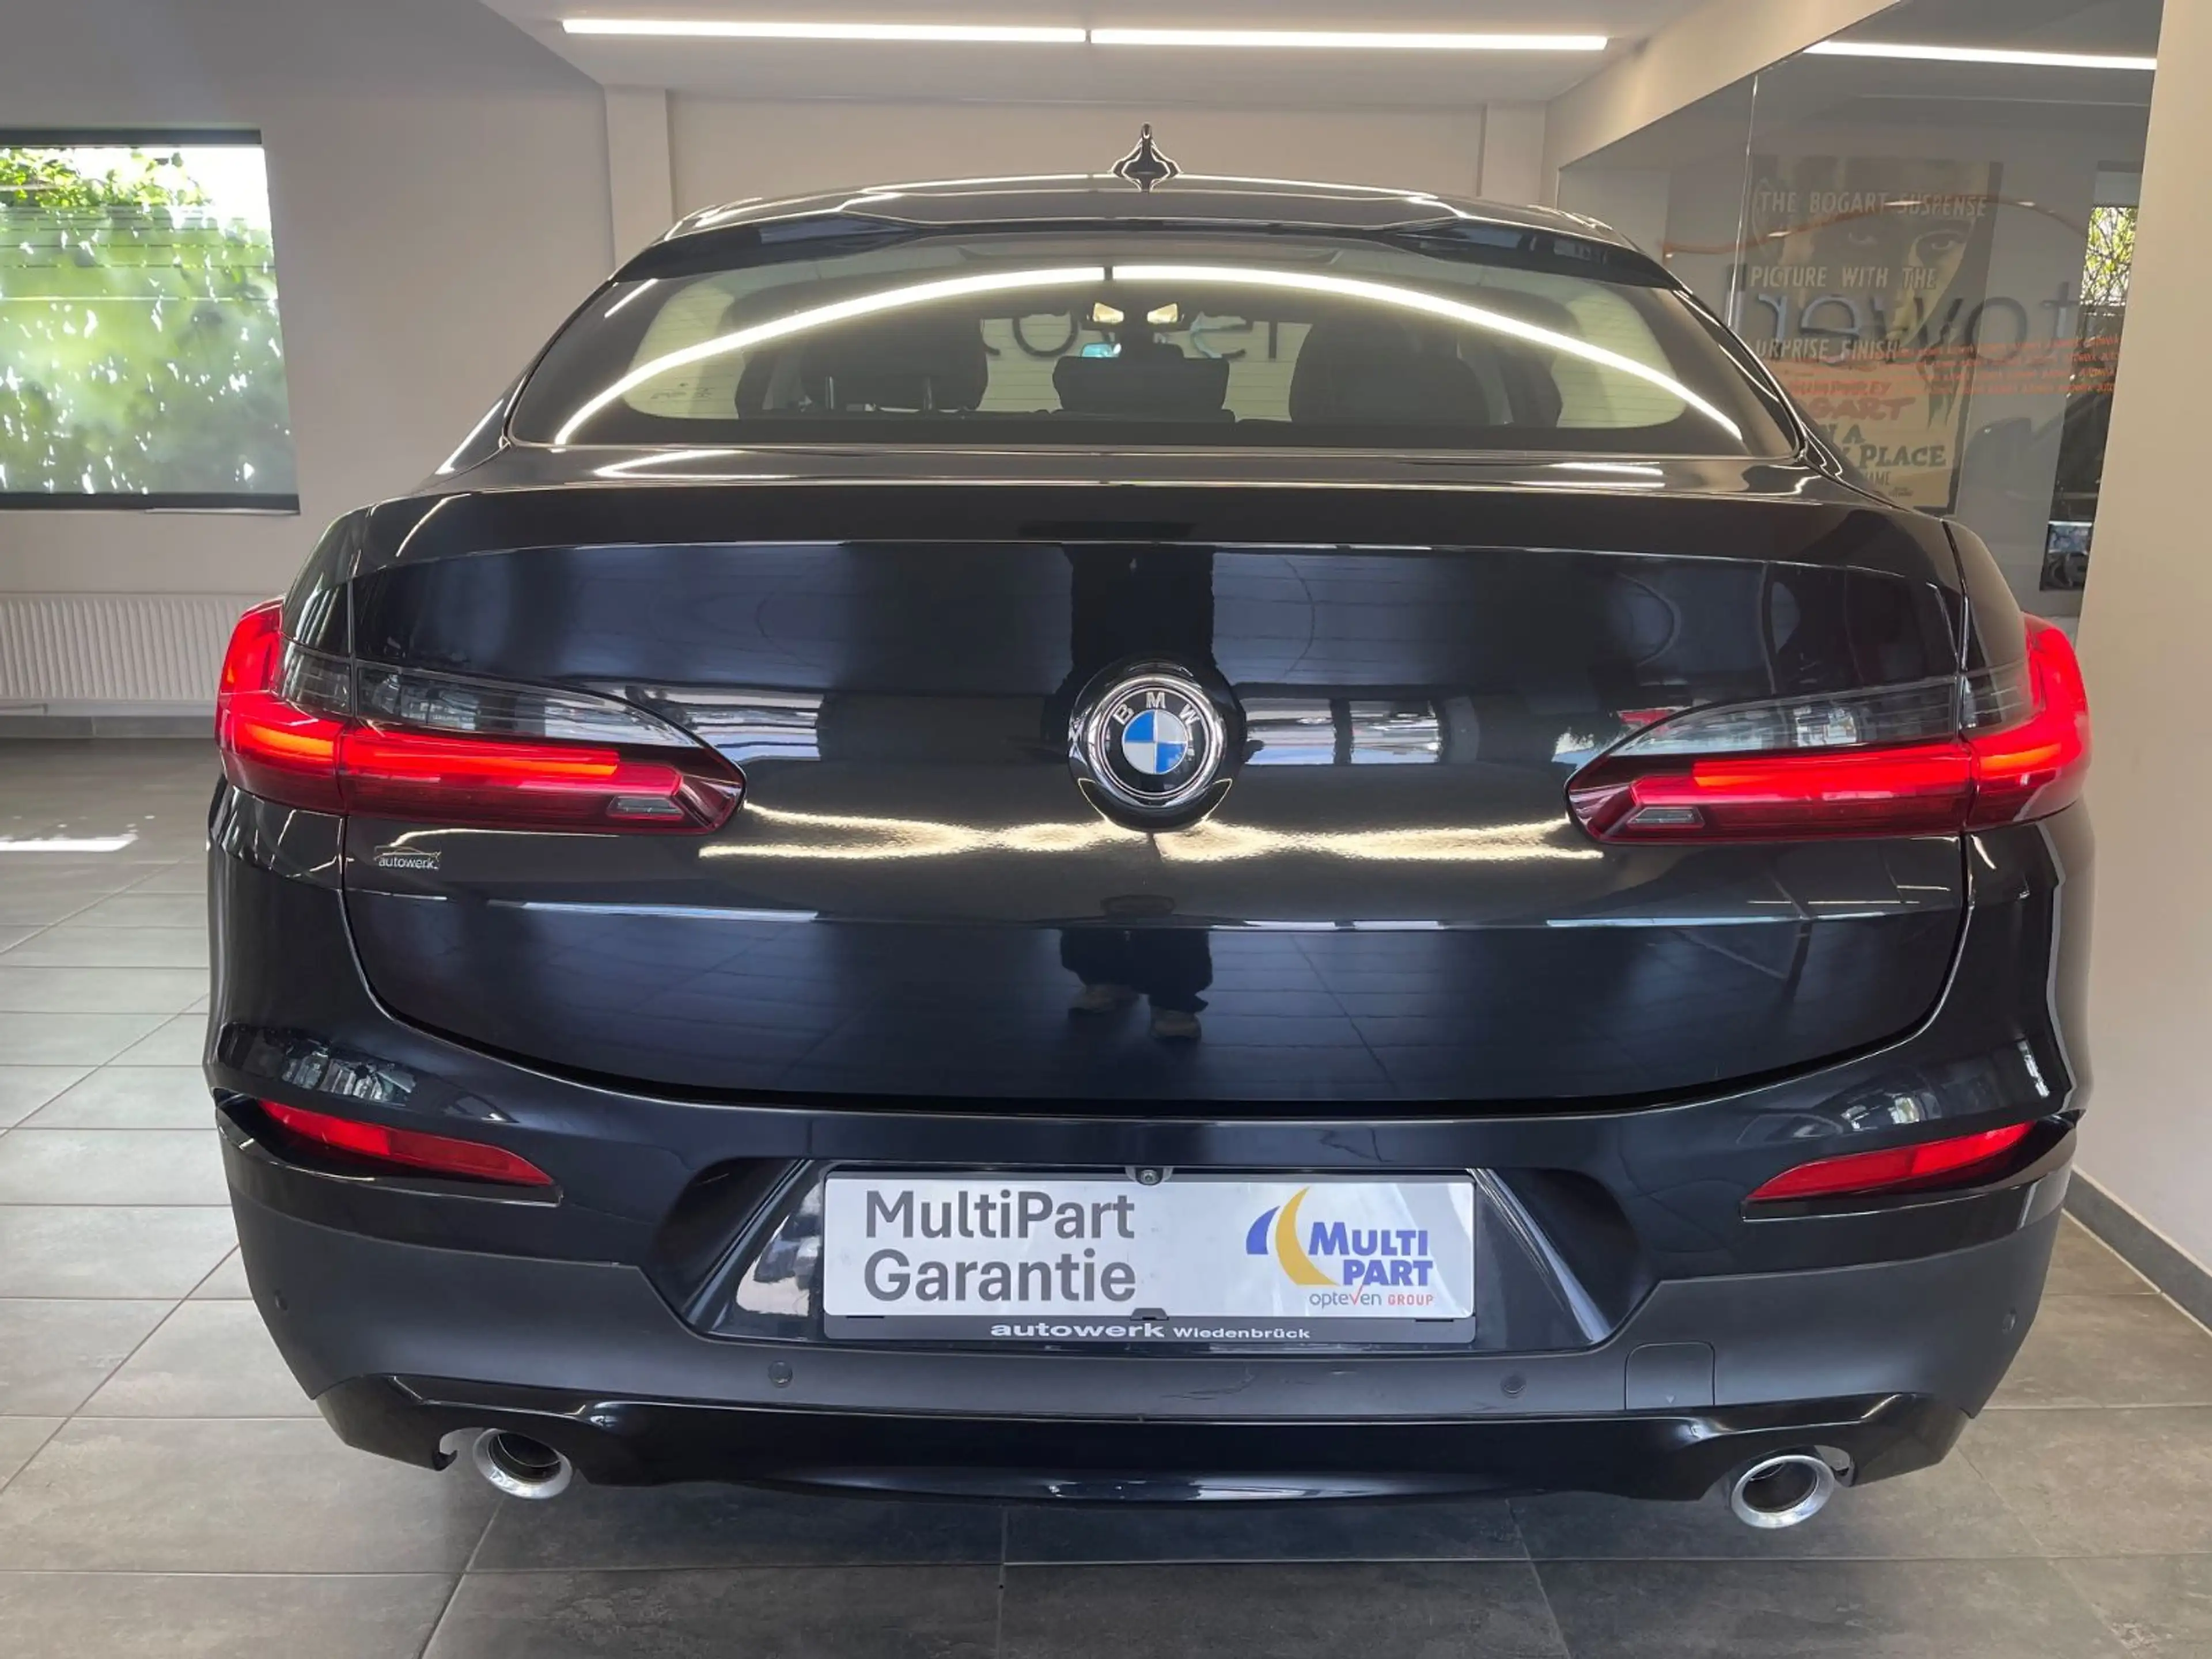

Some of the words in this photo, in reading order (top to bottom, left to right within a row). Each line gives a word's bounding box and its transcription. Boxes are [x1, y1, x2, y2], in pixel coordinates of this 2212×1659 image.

[1760, 191, 1797, 213] THE
[1809, 192, 1890, 215] BOGART
[1897, 194, 1987, 217] SUSPENSE
[1750, 266, 1827, 287] PICTURE
[1843, 267, 1889, 288] WITH
[1903, 267, 1937, 289] THE
[1751, 338, 1830, 360] URPRISE
[1859, 444, 1946, 469] PLACE
[1112, 691, 1200, 726] BMW
[866, 1189, 1135, 1238] MultiPart
[1308, 1221, 1428, 1256] MULTI
[865, 1248, 1136, 1302] Garantie
[1343, 1259, 1433, 1286] PART
[1309, 1287, 1382, 1308] opteven
[1388, 1294, 1433, 1305] GROUP
[991, 1323, 1165, 1338] autowerk
[1172, 1327, 1310, 1339] Wiedenbrück
